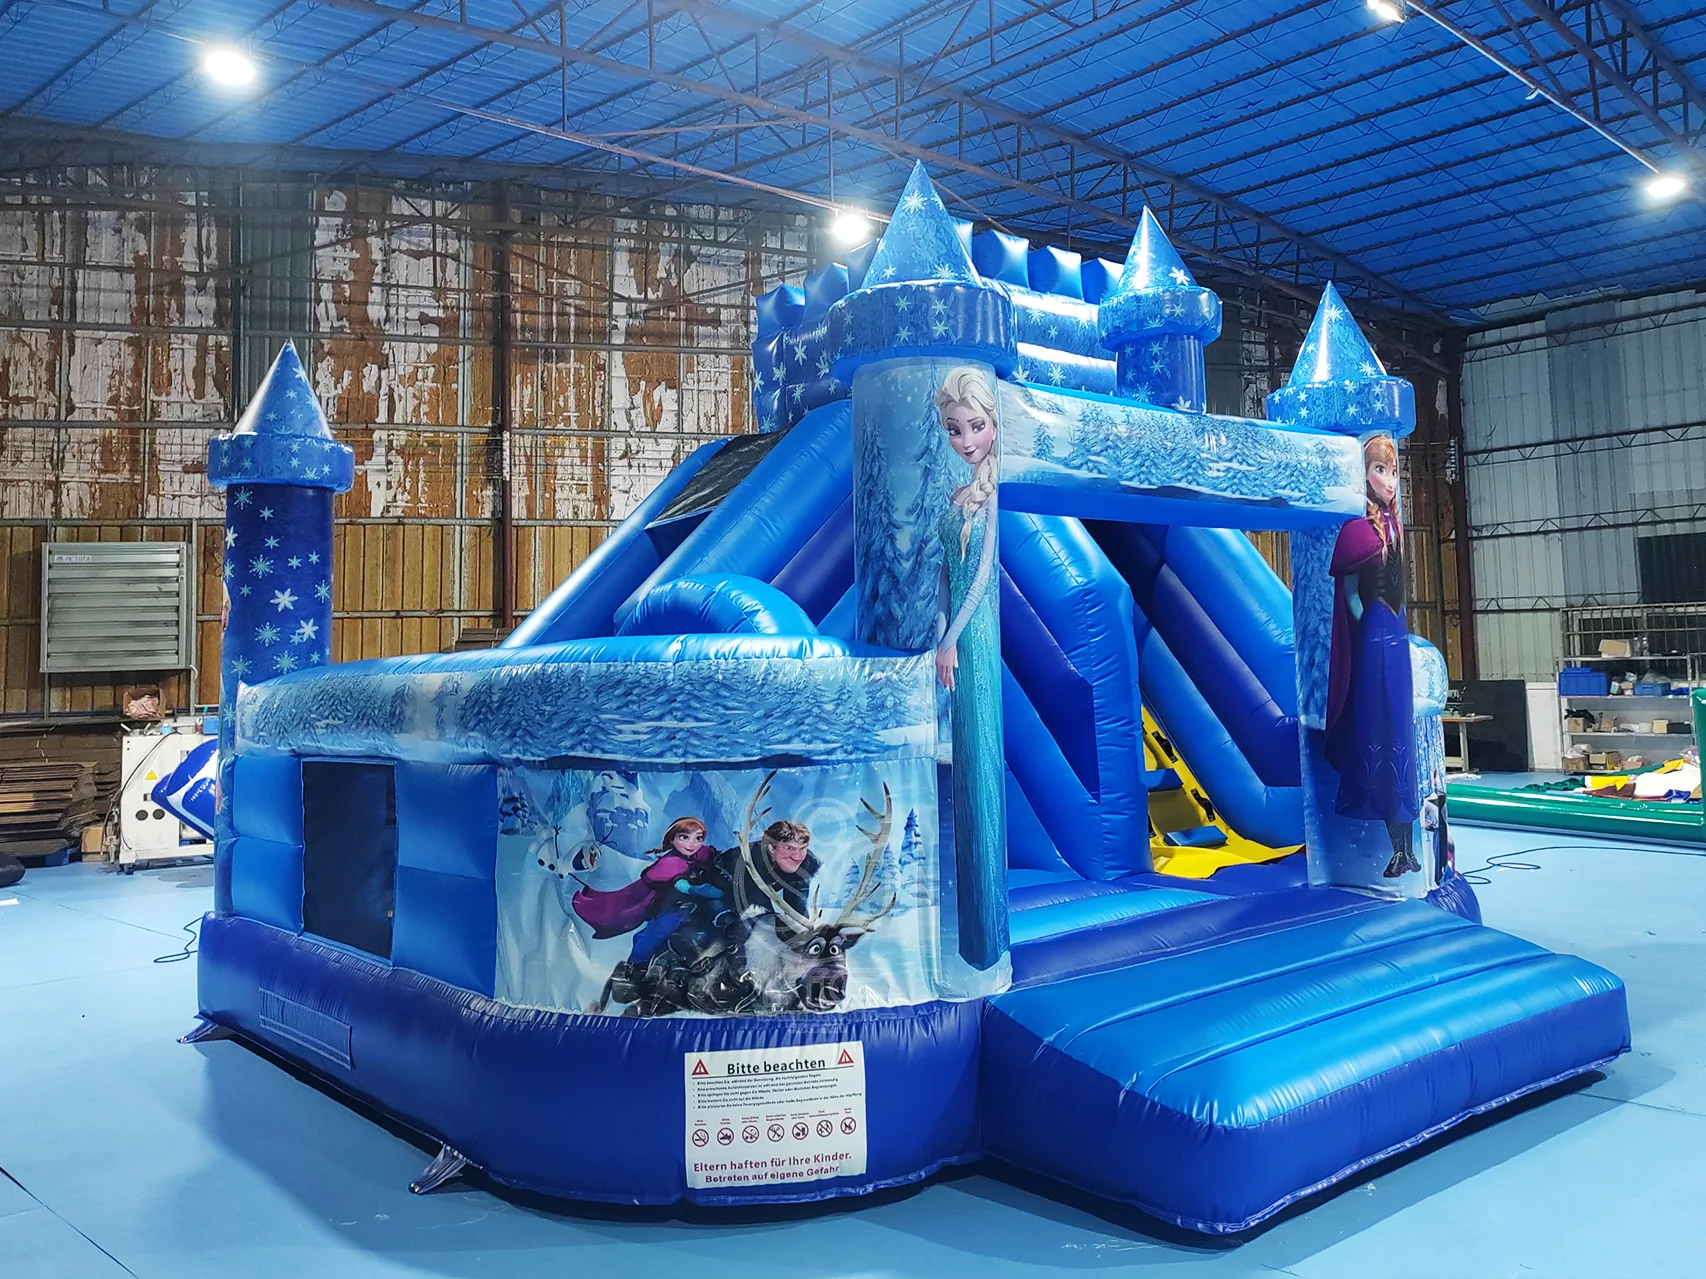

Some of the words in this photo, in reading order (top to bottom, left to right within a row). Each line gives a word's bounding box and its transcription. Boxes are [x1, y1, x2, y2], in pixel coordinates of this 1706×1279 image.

[727, 1062, 760, 1075] Bitte
[764, 1059, 826, 1073] beachten
[693, 1162, 727, 1172] Eltern
[730, 1160, 767, 1170] haften
[771, 1157, 785, 1167] für
[789, 1156, 811, 1166] Ihre
[813, 1151, 852, 1163] Kinder.
[705, 1174, 749, 1183] Betreten
[752, 1172, 768, 1180] auf
[770, 1171, 804, 1179] eigene
[806, 1166, 840, 1176] Gefahr
